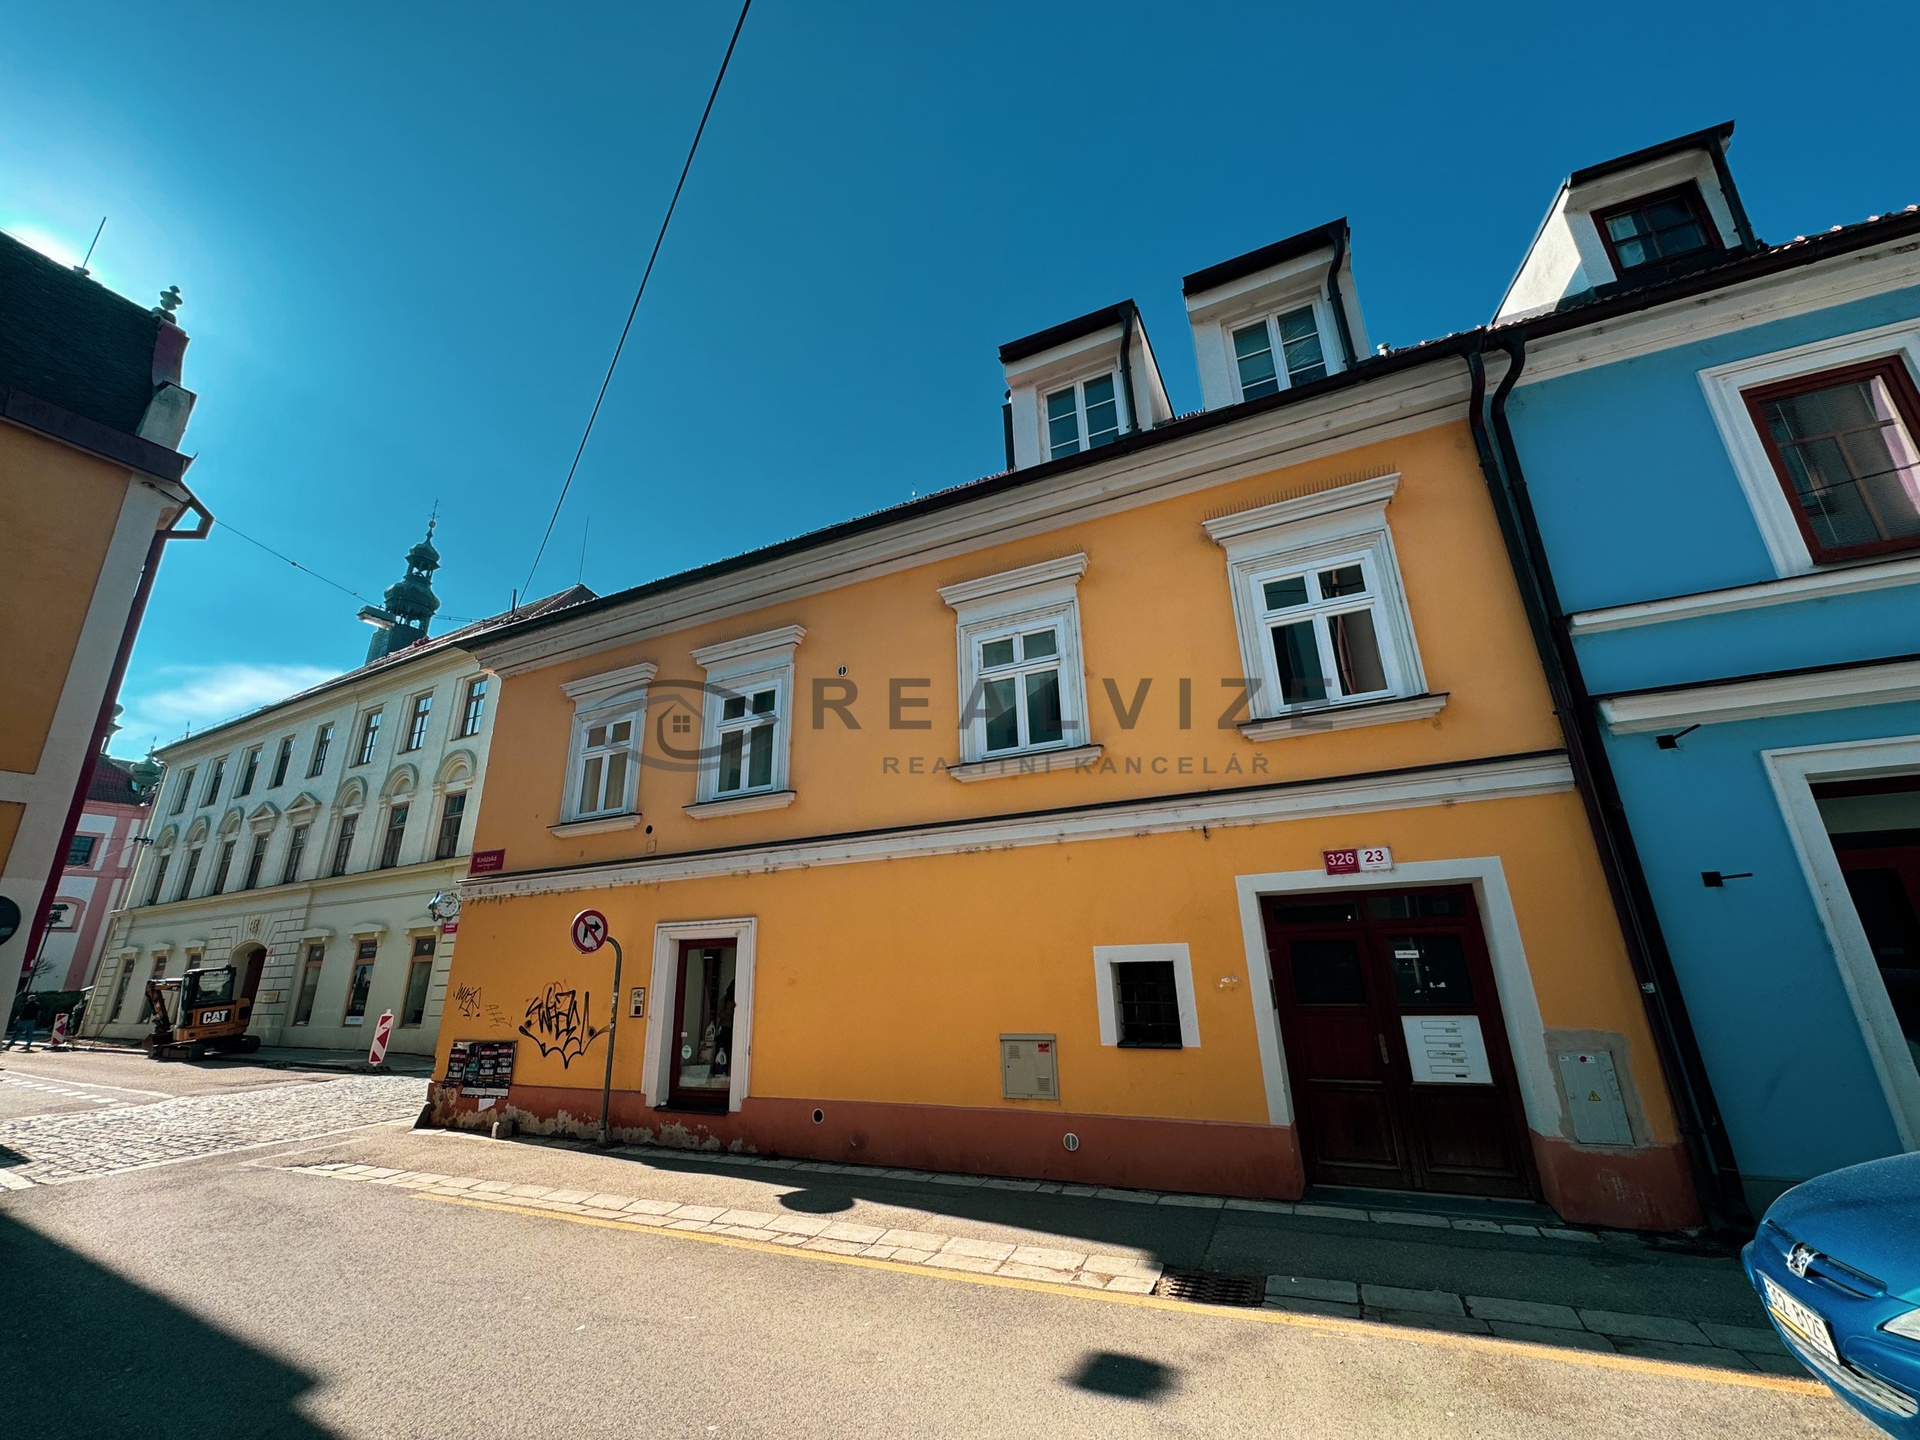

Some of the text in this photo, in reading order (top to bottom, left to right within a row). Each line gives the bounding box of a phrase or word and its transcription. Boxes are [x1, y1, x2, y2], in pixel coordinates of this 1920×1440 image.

[1327, 852, 1355, 866] 326
[1364, 849, 1384, 863] 23
[202, 1010, 228, 1024] CAT
